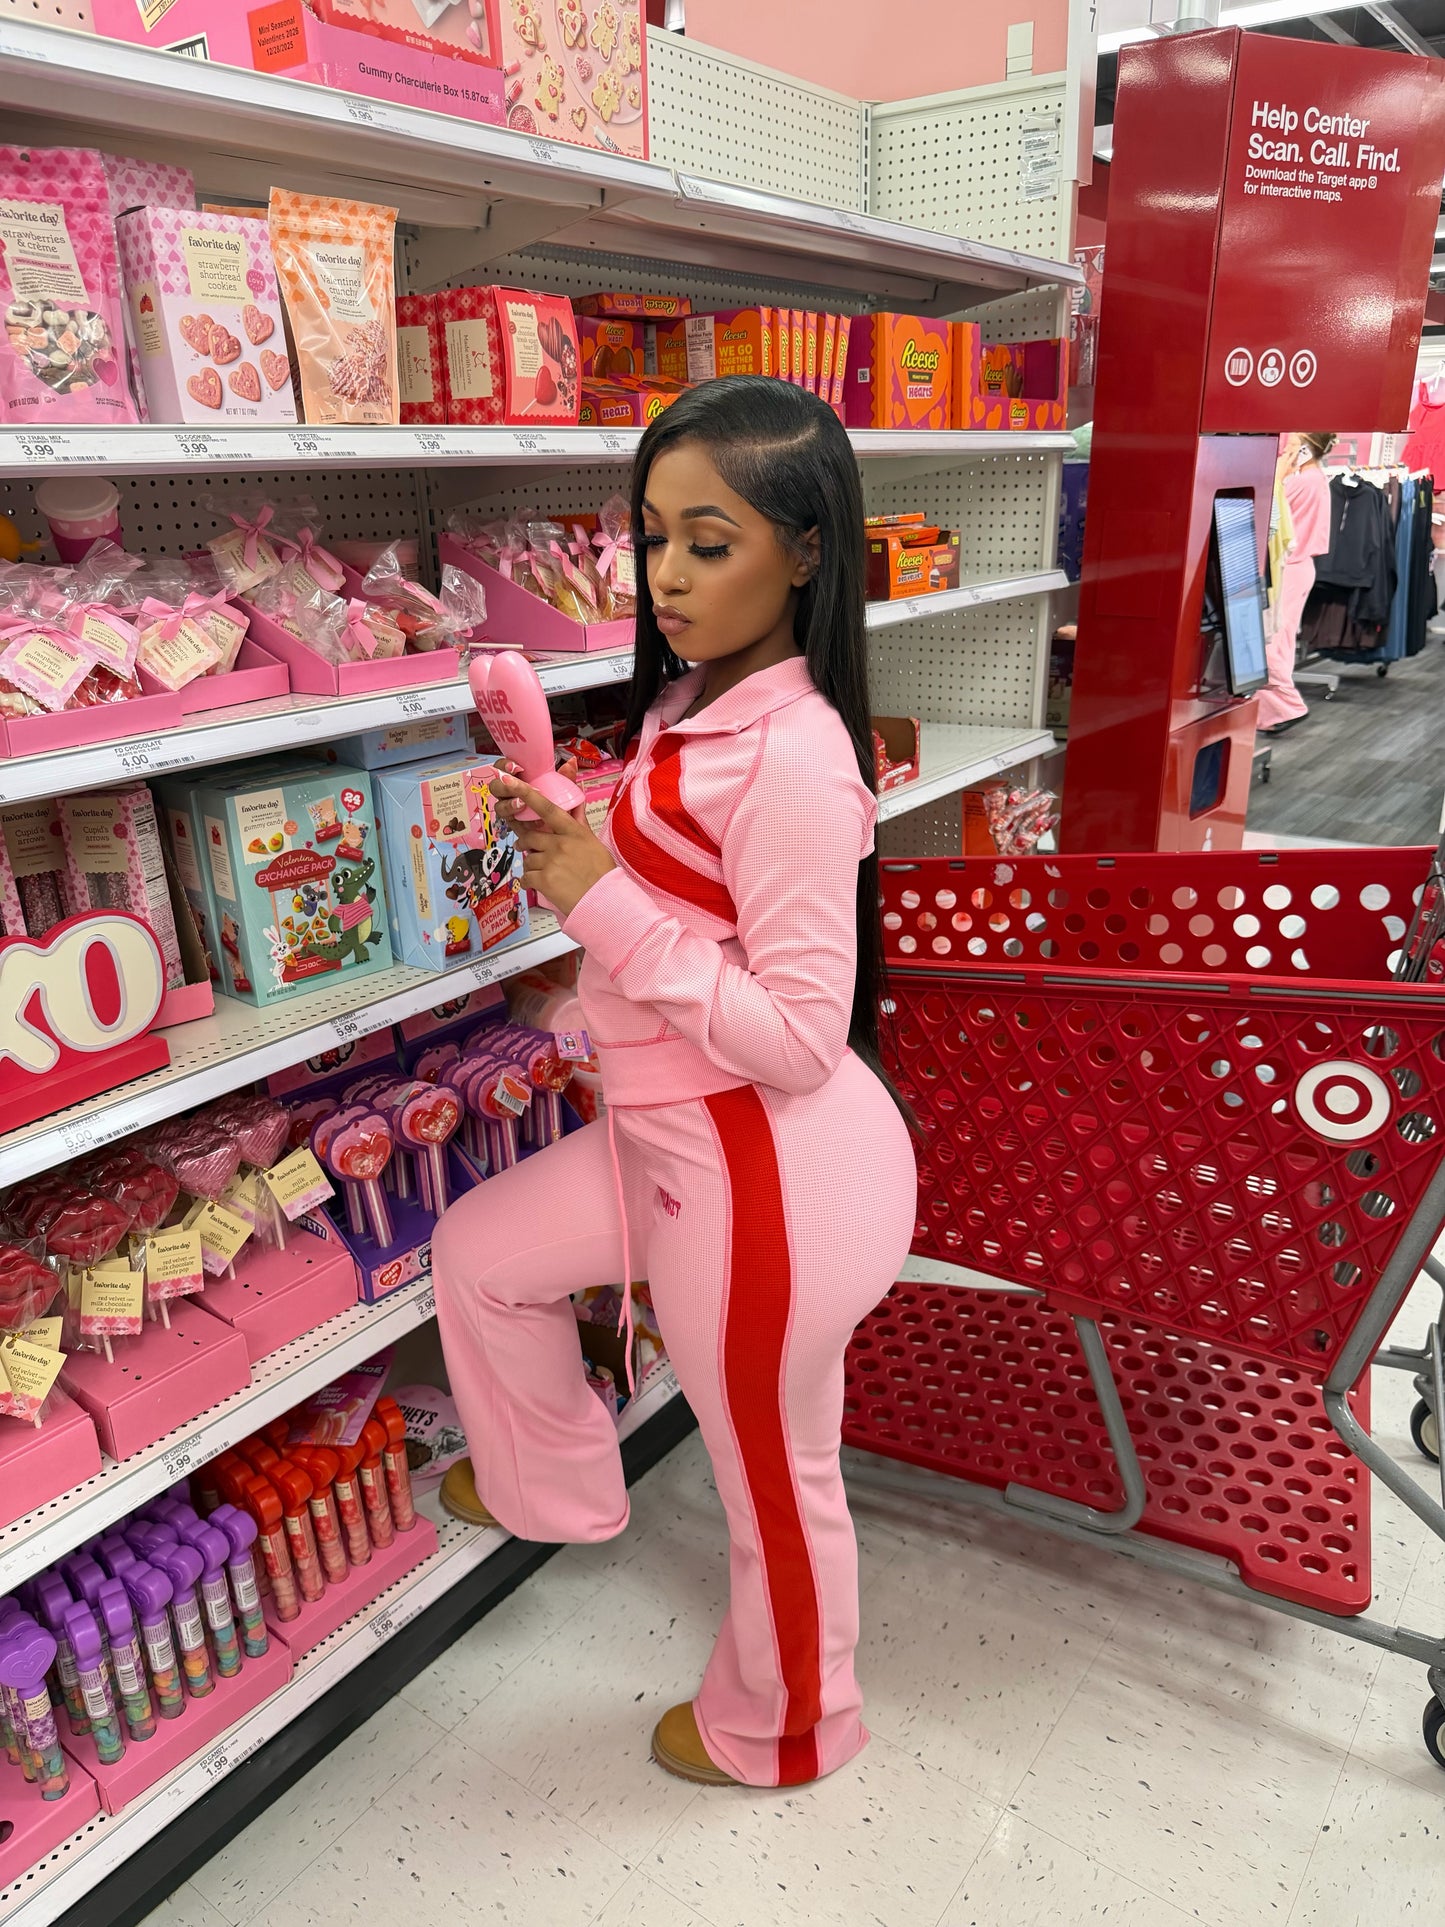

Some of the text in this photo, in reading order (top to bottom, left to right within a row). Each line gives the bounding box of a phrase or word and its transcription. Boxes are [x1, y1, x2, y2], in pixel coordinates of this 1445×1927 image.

[258, 16, 296, 35] Mini Seasonal
[257, 33, 286, 47] Valentines
[358, 62, 489, 104] Gummy Charcuterie Box 15.87oz
[348, 108, 373, 121] 9.99
[1251, 100, 1370, 139] Help Center
[1248, 133, 1401, 173] Scan. Call. Find.
[1245, 165, 1368, 190] Download the Target app
[1244, 182, 1343, 204] for interactive maps.
[40, 213, 59, 227] day
[2, 229, 66, 244] strawberries
[17, 239, 58, 252] & crème
[188, 236, 241, 254] favorite day
[198, 260, 240, 272] strawberry
[316, 252, 361, 268] favorite day
[199, 270, 241, 282] shortbread
[248, 277, 264, 287] LOVE
[320, 274, 361, 288] Valentine's
[207, 282, 237, 292] cookies
[328, 287, 358, 299] crunchy
[645, 299, 677, 315] Reese's
[605, 323, 625, 336] Reese's
[723, 330, 747, 340] Reese's
[719, 344, 753, 357] WE GO
[901, 338, 940, 370] Reese's
[719, 356, 753, 365] TOGETHER
[720, 364, 747, 375] LIKE PB
[907, 385, 933, 399] Hearts
[602, 404, 630, 420] Heart
[22, 444, 55, 456] 3.99
[181, 443, 208, 454] 3.99
[294, 441, 318, 451] 2.99
[420, 440, 440, 450] 3.99
[519, 440, 537, 449] 4.00
[604, 440, 620, 448] 2.99
[896, 551, 924, 568] Reese's
[38, 637, 65, 655] favorite
[34, 650, 62, 670] raspberry
[612, 664, 628, 675] 4.00
[402, 702, 423, 713] 4.00
[124, 740, 162, 752] CHOCOLATE
[122, 754, 149, 768] 4.00
[433, 780, 461, 792] favorite day
[343, 791, 361, 806] 24
[241, 800, 280, 813] favorite day
[2, 808, 50, 822] favorite day
[72, 809, 114, 818] favorite day
[83, 825, 109, 835] Cupid's
[243, 822, 266, 832] gummy
[266, 819, 283, 827] candy
[15, 826, 45, 839] Cupid's
[17, 836, 46, 846] arrows
[277, 854, 314, 868] Valentine
[258, 865, 310, 884] EXCHANGE
[311, 859, 334, 872] PACK
[481, 901, 513, 928] EXCHANGE
[490, 916, 508, 933] PACK
[474, 968, 493, 981] 5.99
[335, 1022, 358, 1038] 5.99
[64, 1129, 93, 1148] 5.00
[277, 1160, 307, 1181] favorite day
[282, 1174, 321, 1200] chocolate pop
[291, 1177, 306, 1188] milk
[209, 1214, 241, 1235] favorite day
[209, 1230, 223, 1242] milk
[157, 1241, 191, 1253] favorite day
[220, 1245, 232, 1255] pop
[156, 1260, 194, 1273] milk chocolate
[171, 1256, 188, 1264] velvet
[162, 1266, 190, 1277] candy pop
[93, 1281, 131, 1291] favorite day
[418, 1299, 436, 1315] 2.99
[11, 1349, 51, 1366] favorite day
[20, 1368, 38, 1377] velvet
[14, 1375, 43, 1386] chocolate
[23, 1383, 33, 1391] pop
[169, 1434, 202, 1457] CHOCOLATE
[167, 1454, 191, 1475] 2.99
[374, 1619, 393, 1638] 5.99
[207, 1745, 225, 1760] CANDY
[206, 1755, 228, 1776] 1.99
